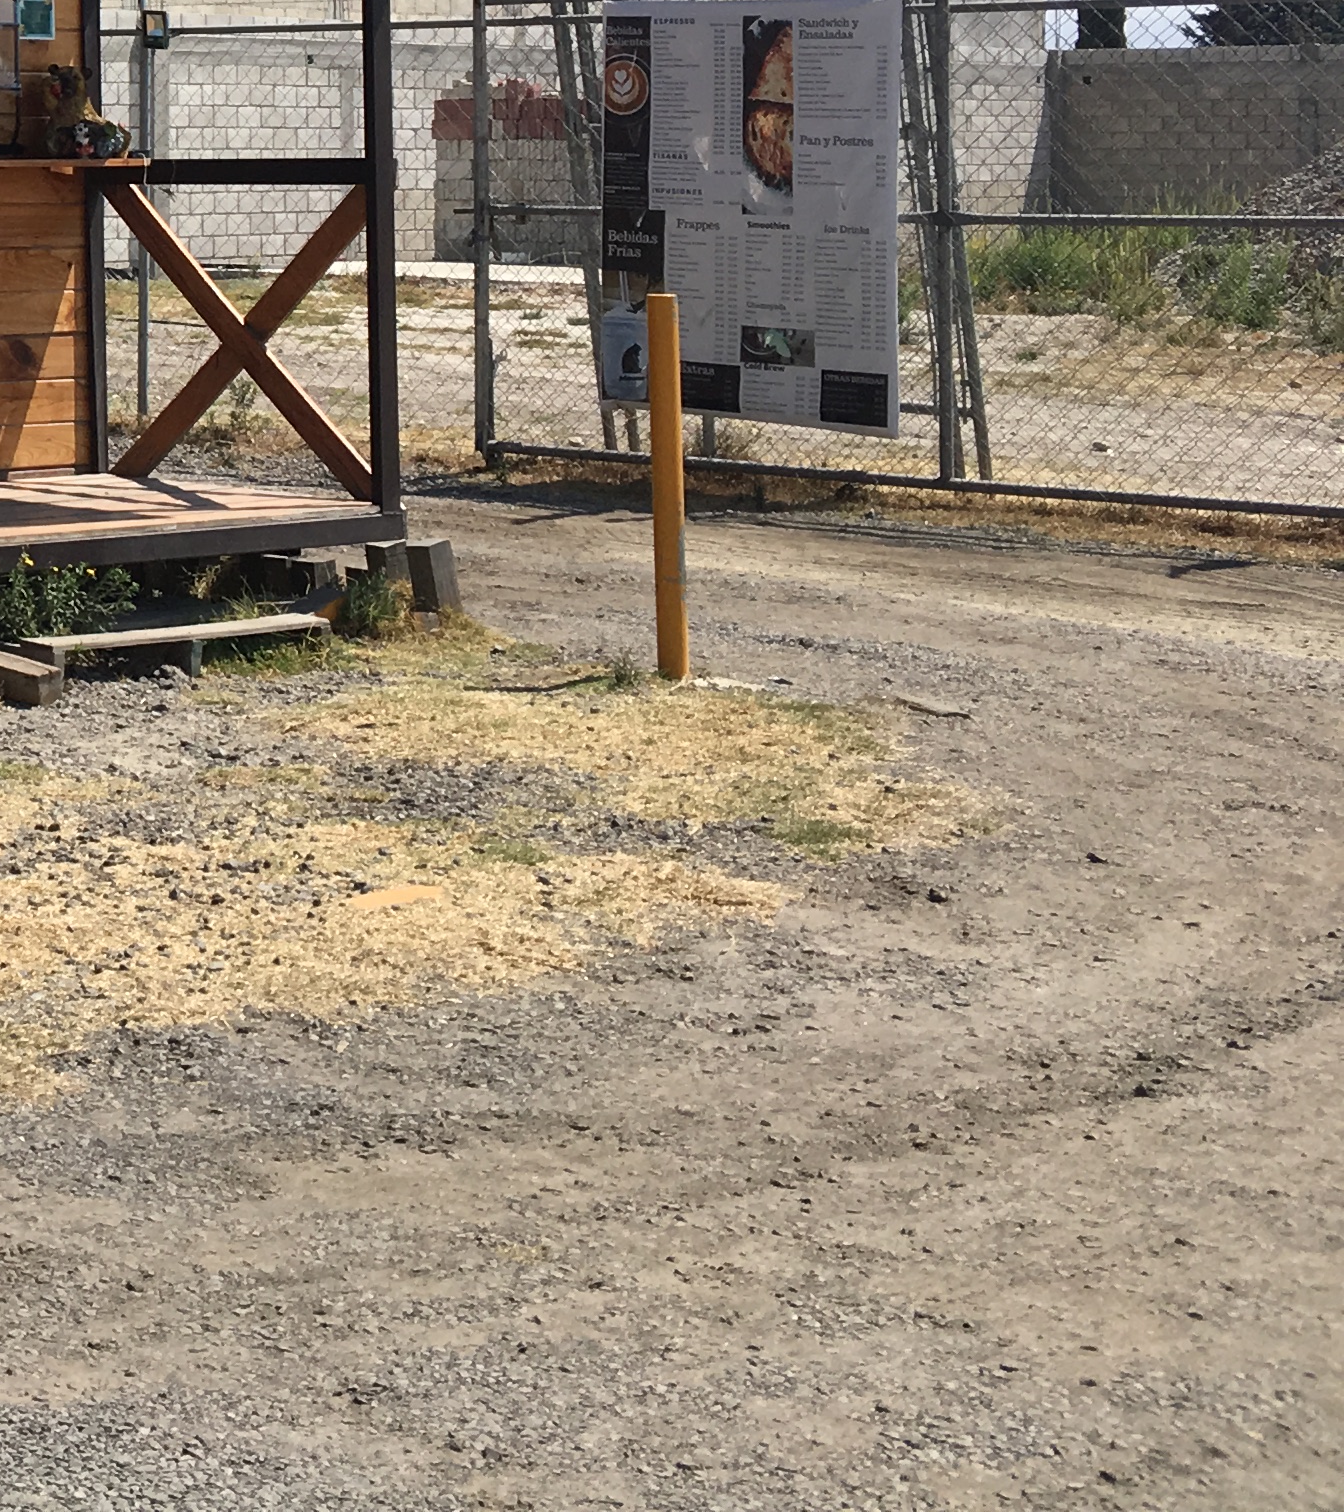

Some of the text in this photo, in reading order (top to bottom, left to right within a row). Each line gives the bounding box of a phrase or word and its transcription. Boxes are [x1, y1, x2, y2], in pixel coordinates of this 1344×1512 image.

[798, 17, 860, 29] Sandwich y
[798, 29, 854, 39] Ensaladas
[799, 135, 874, 148] Pan y Postres
[607, 229, 659, 244] Bebidas
